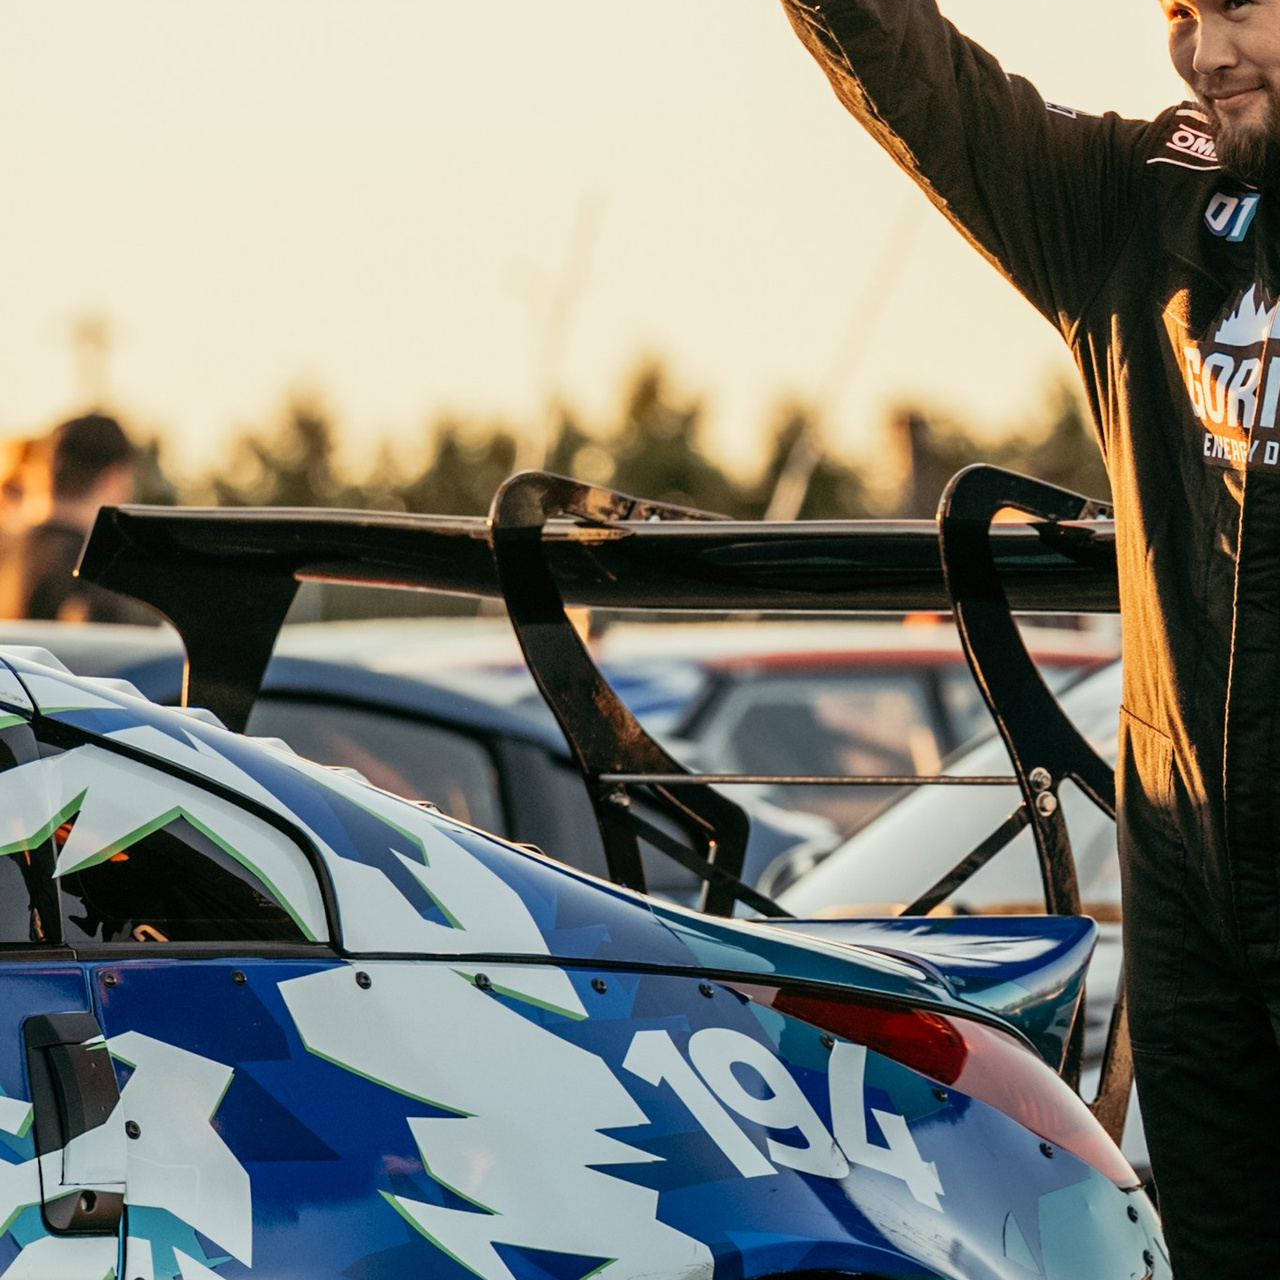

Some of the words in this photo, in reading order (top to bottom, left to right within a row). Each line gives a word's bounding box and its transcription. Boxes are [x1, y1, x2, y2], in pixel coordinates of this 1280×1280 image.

[1172, 130, 1217, 157] OM
[1203, 433, 1260, 463] ENERGY
[622, 1027, 946, 1213] 194
